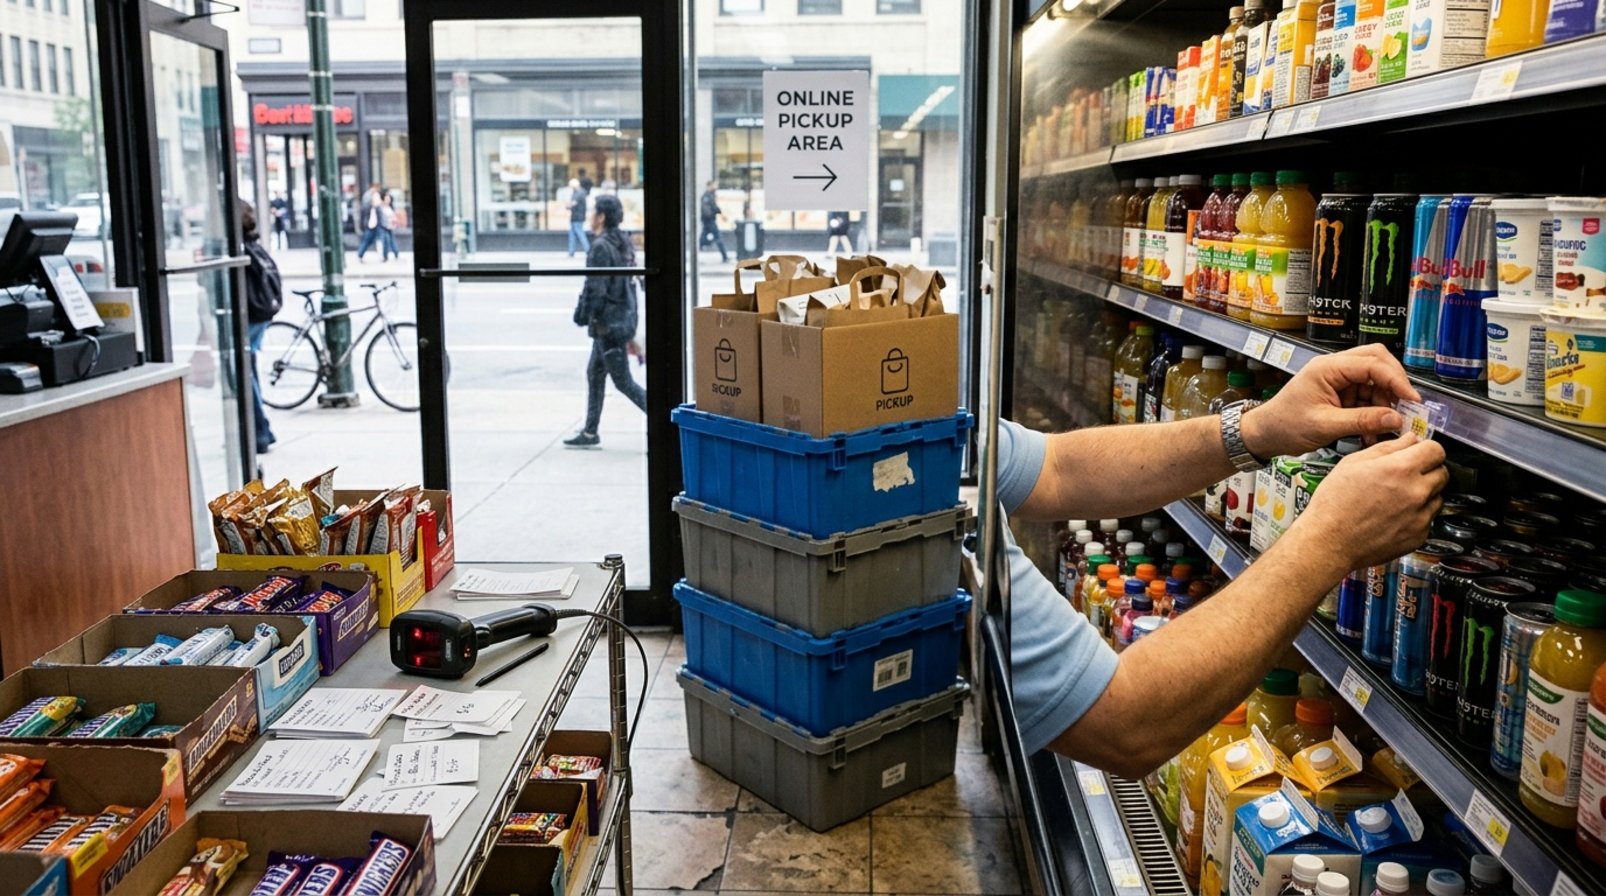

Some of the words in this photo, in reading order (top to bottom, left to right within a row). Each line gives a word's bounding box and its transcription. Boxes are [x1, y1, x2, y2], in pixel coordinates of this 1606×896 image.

[777, 90, 854, 106] ONLINE
[778, 112, 853, 128] PICKUP
[787, 135, 843, 151] AREA
[1450, 258, 1486, 279] Bull
[875, 395, 914, 411] PICKUP
